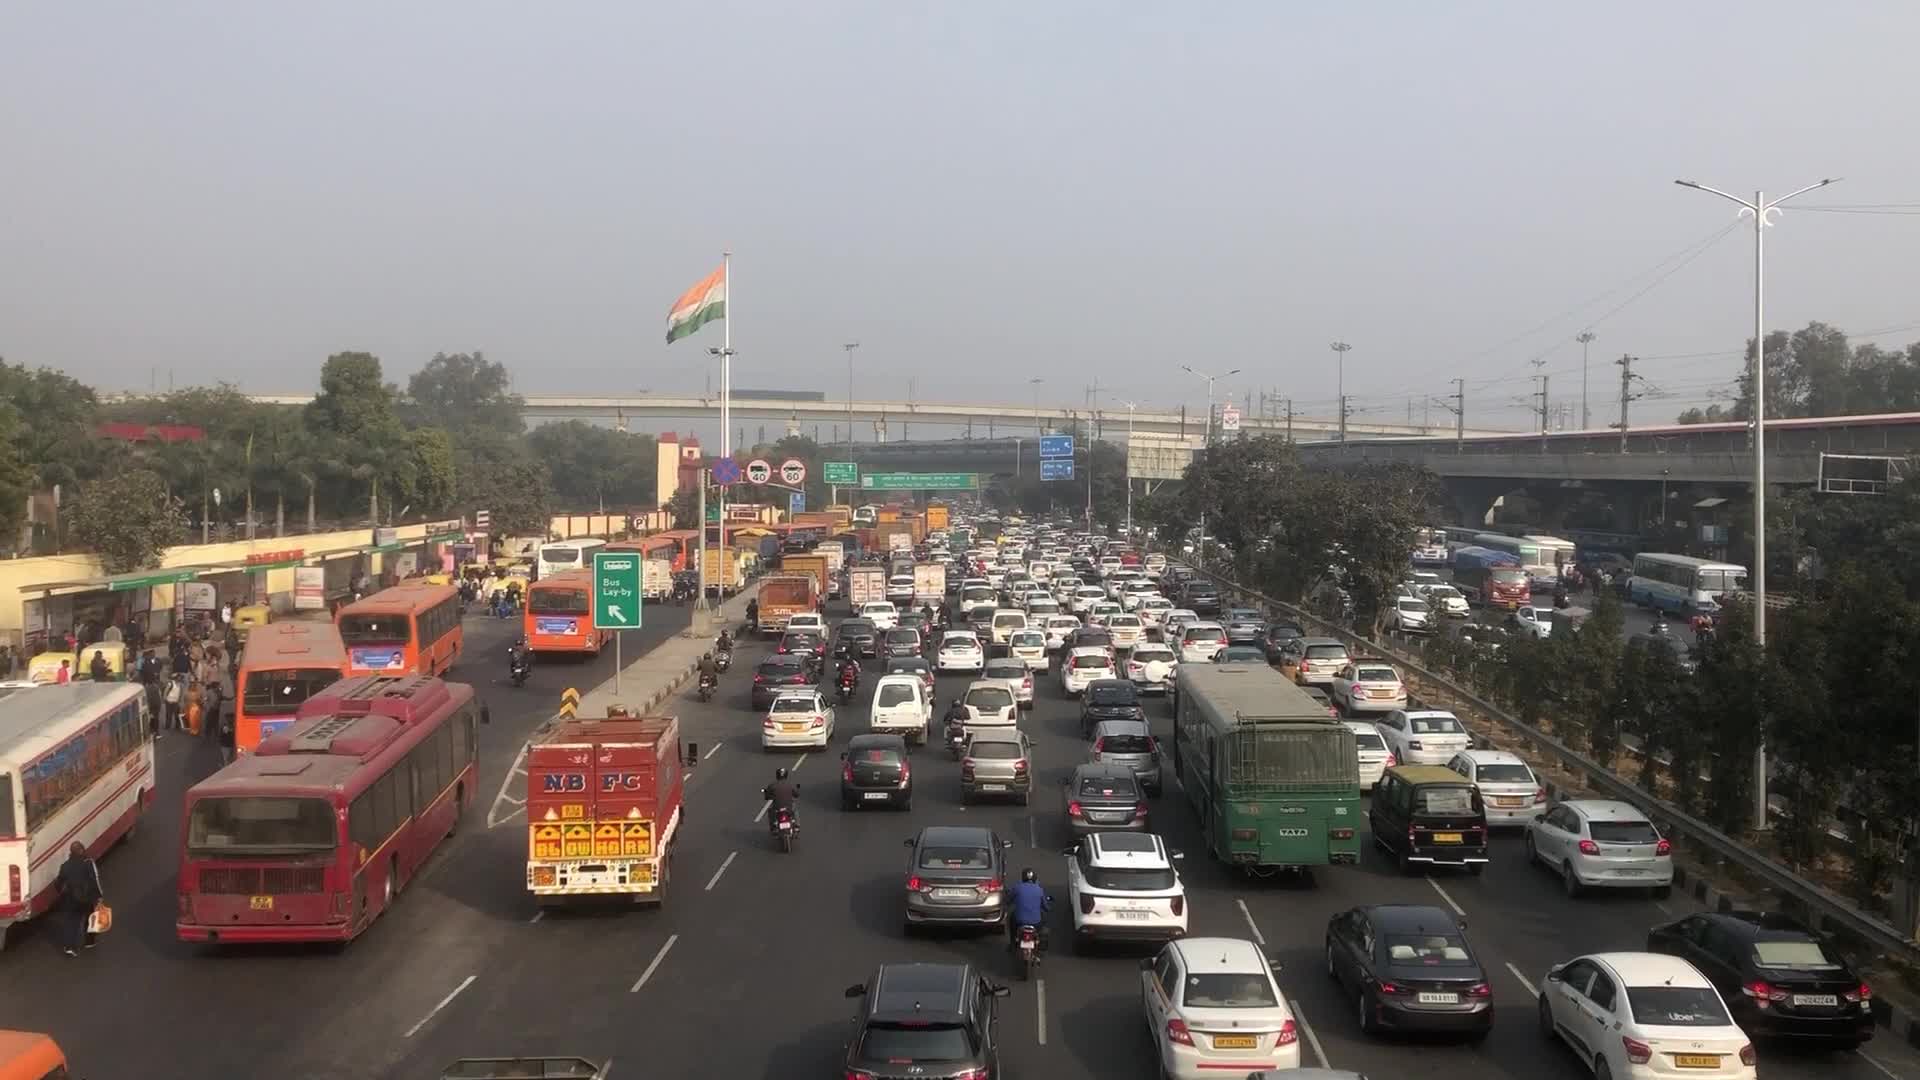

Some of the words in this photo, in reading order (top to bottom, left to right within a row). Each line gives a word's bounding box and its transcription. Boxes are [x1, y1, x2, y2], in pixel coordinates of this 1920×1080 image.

[753, 473, 766, 482] 40
[786, 472, 800, 482] 60
[603, 578, 620, 587] Bus
[603, 588, 632, 597] Lay-by
[543, 774, 586, 793] NB
[601, 773, 641, 792] FC
[1668, 1012, 1694, 1021] Uber
